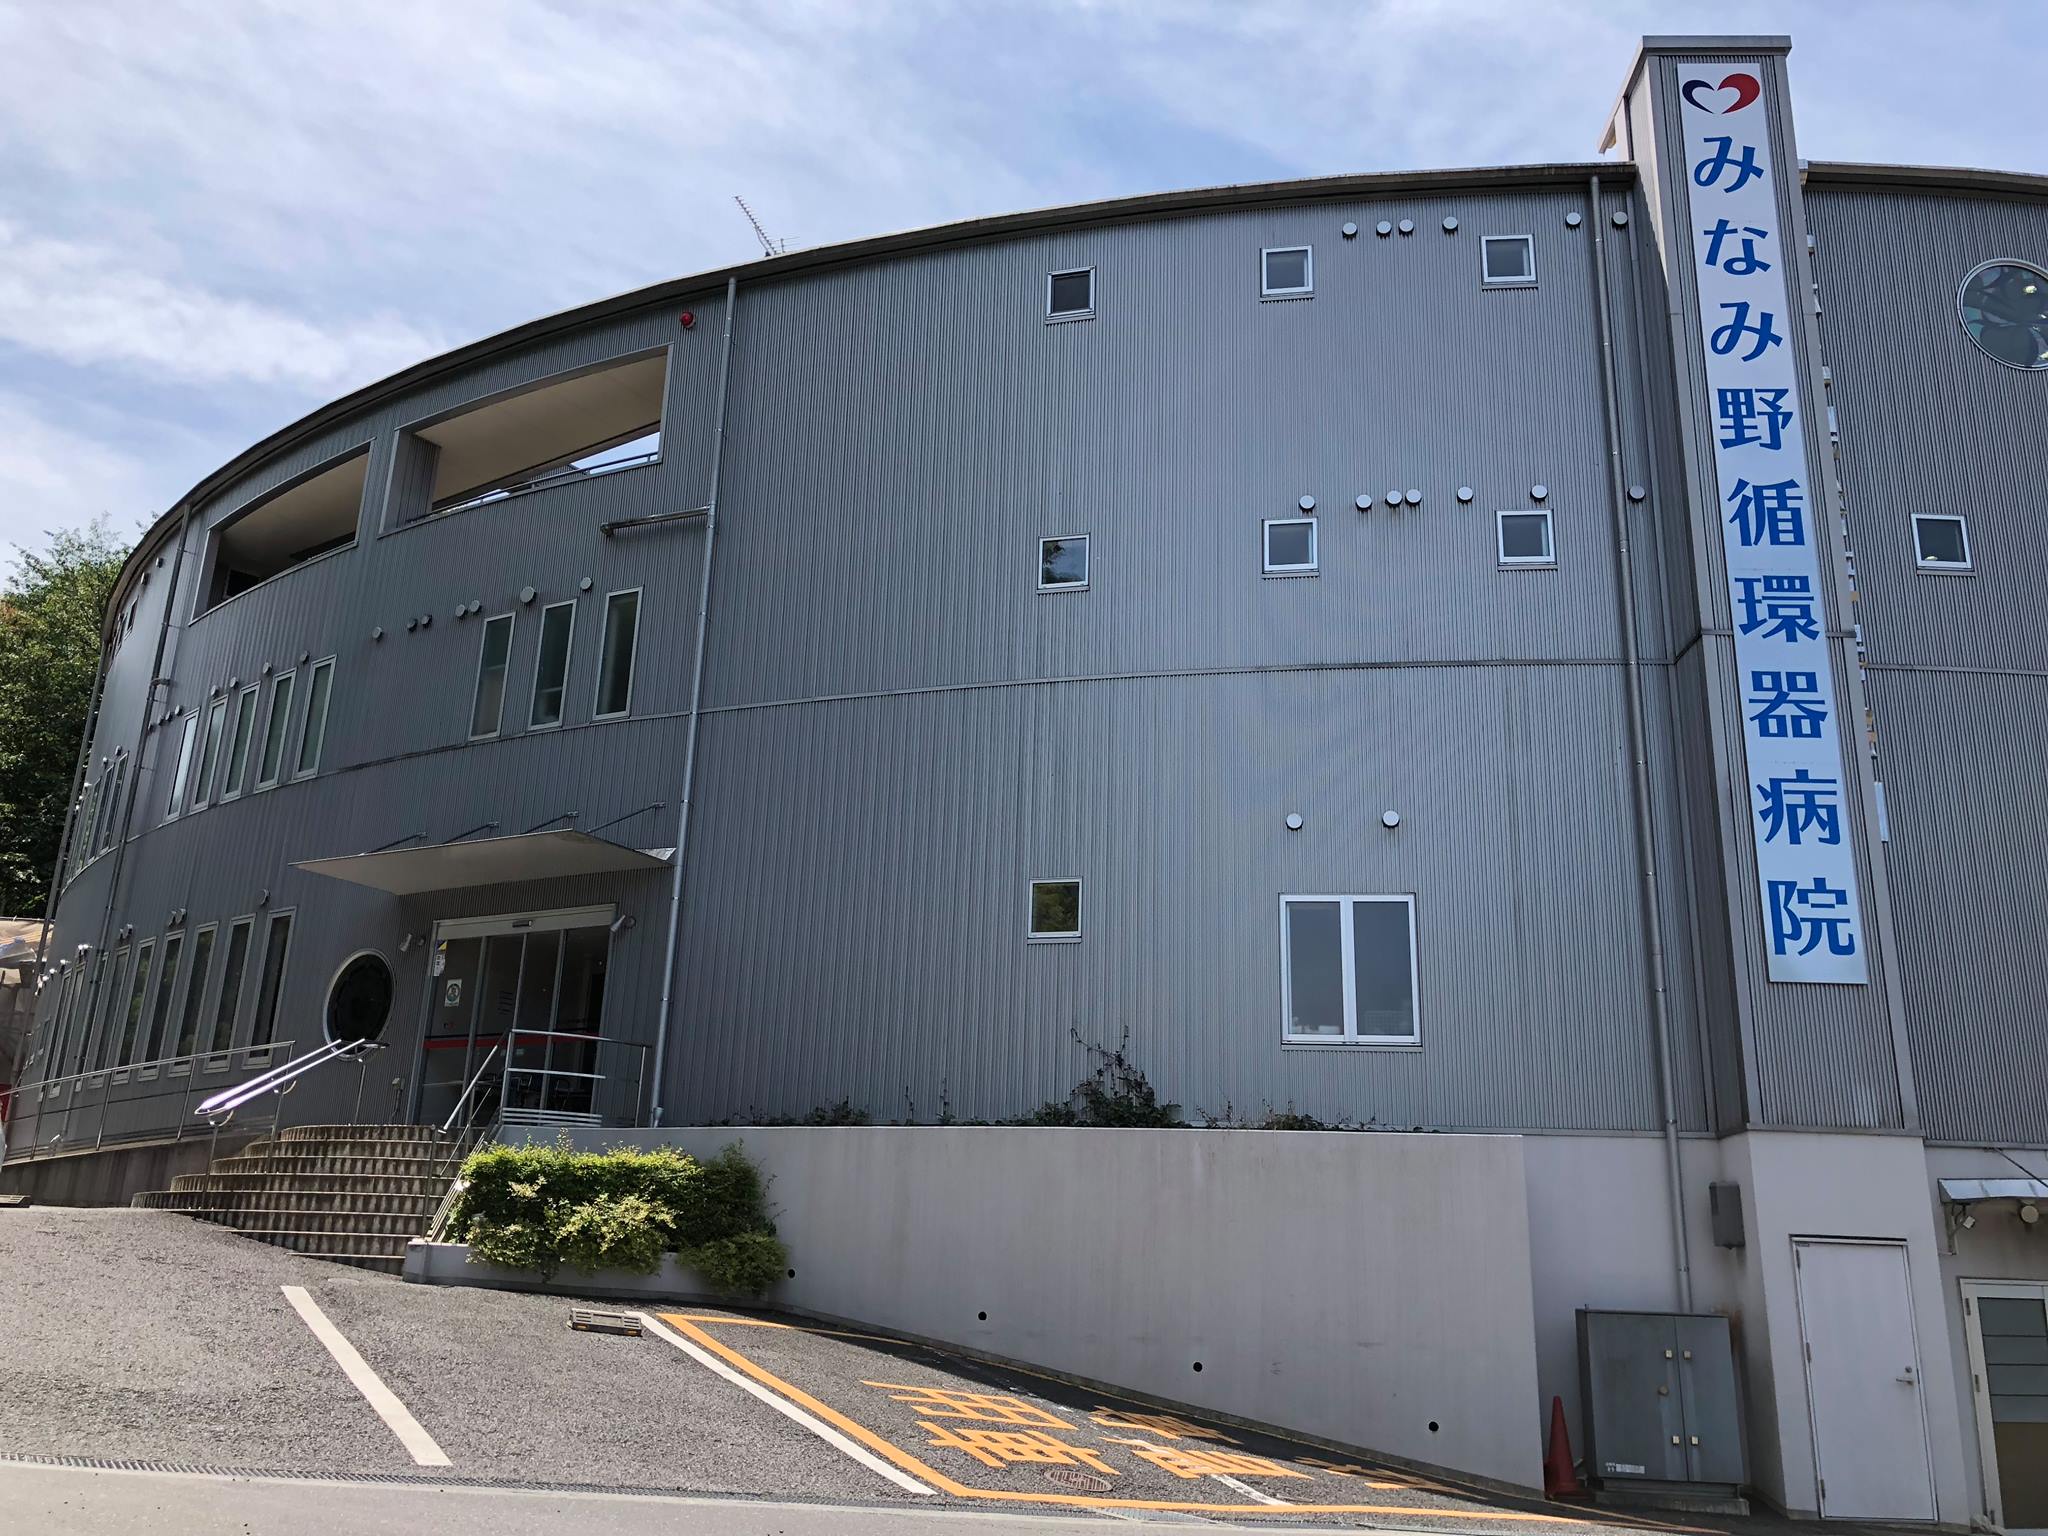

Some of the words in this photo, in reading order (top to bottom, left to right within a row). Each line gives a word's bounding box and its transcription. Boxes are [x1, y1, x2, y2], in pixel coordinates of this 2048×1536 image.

[1693, 134, 1856, 957] みなみ野循環器病院
